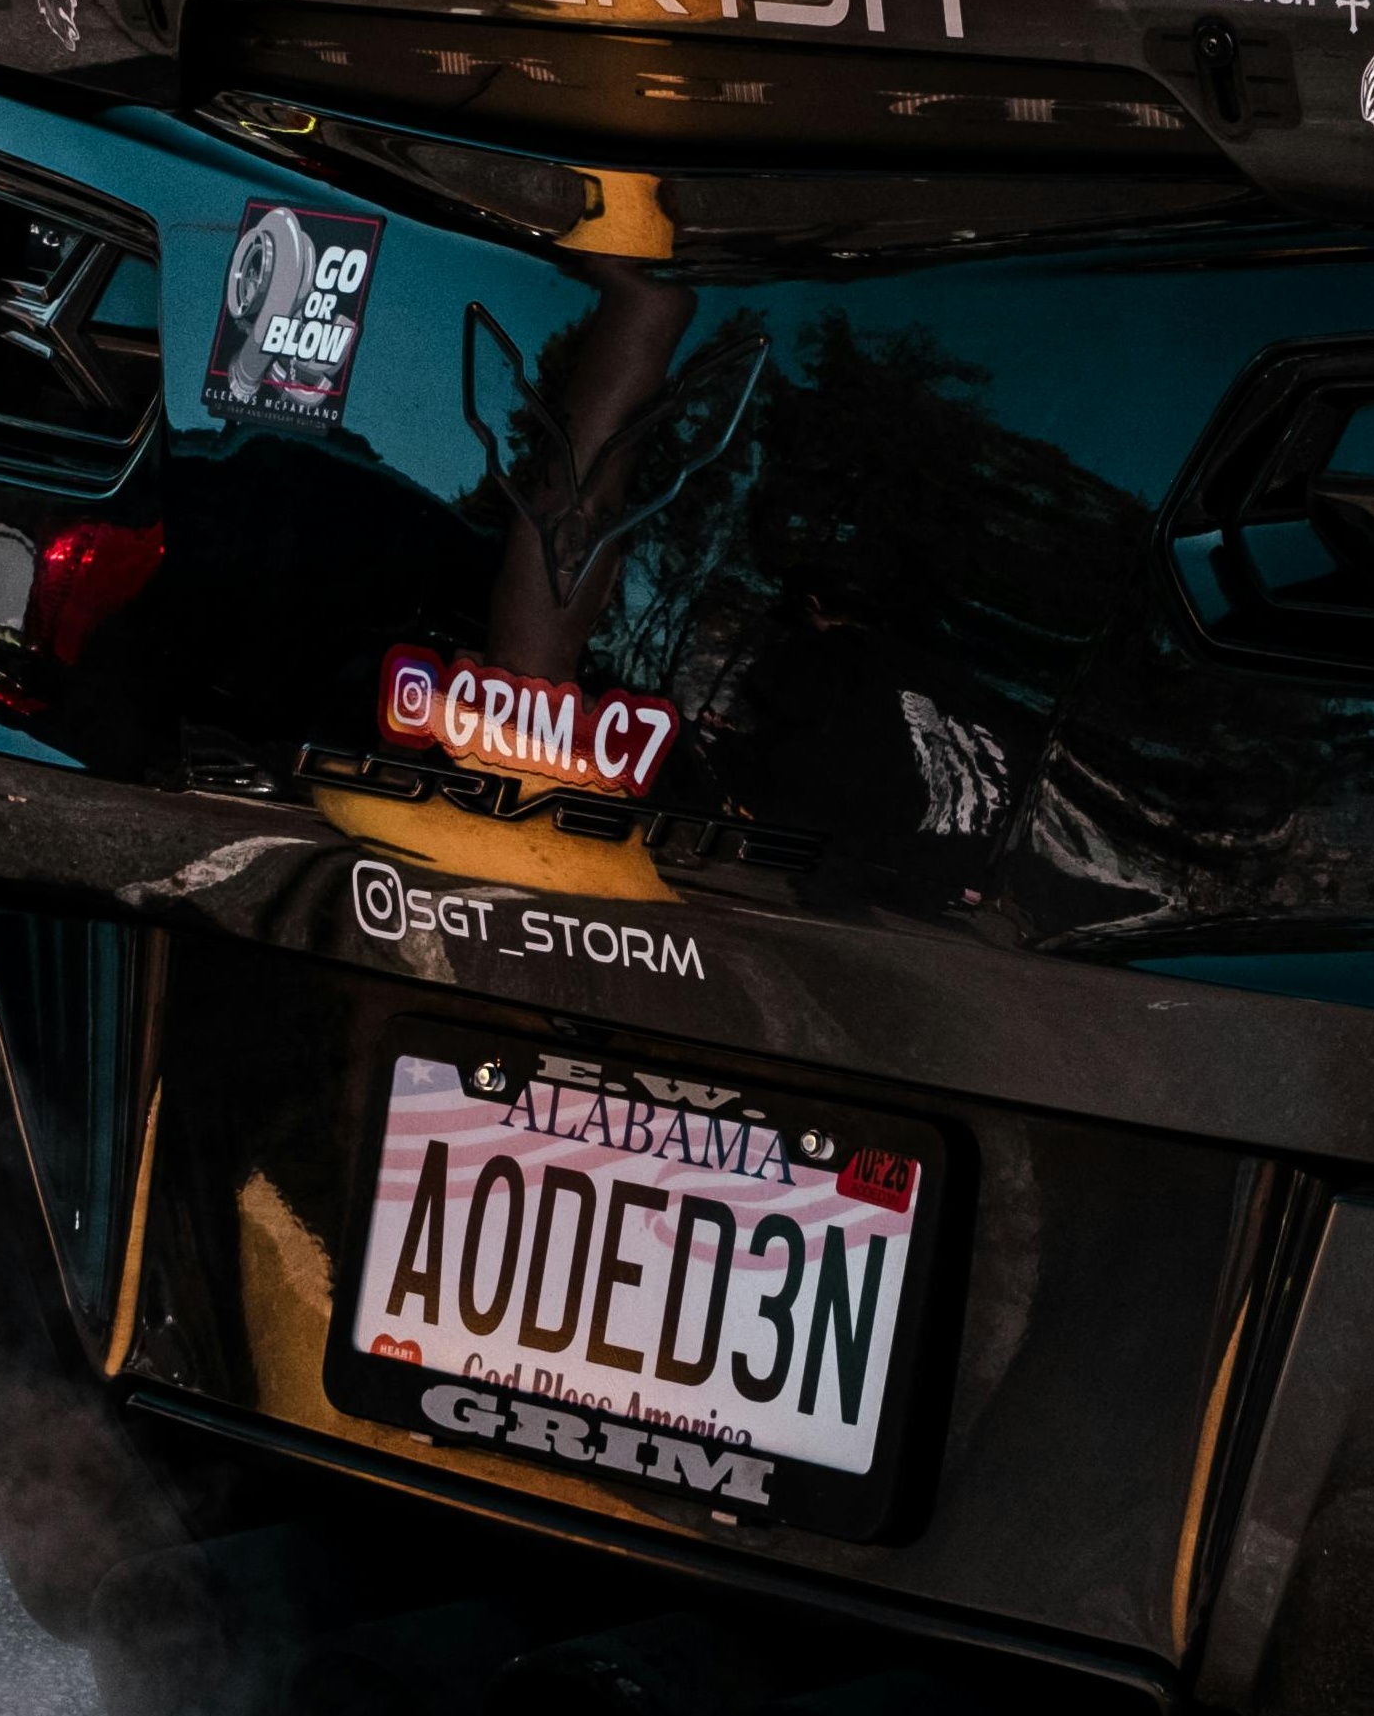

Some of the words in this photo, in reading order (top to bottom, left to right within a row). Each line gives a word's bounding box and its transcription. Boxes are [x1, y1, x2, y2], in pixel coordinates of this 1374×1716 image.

[304, 291, 337, 320] OR
[315, 246, 368, 293] GO
[261, 315, 353, 364] BLOW
[444, 669, 672, 785] GRIM.C7
[293, 742, 834, 873] CORVETTE
[406, 890, 705, 980] SGT_STORM
[538, 1053, 766, 1120] E.W.
[500, 1081, 797, 1186] ALABAMA
[379, 1344, 415, 1361] HEART
[421, 1384, 775, 1506] GRIM
